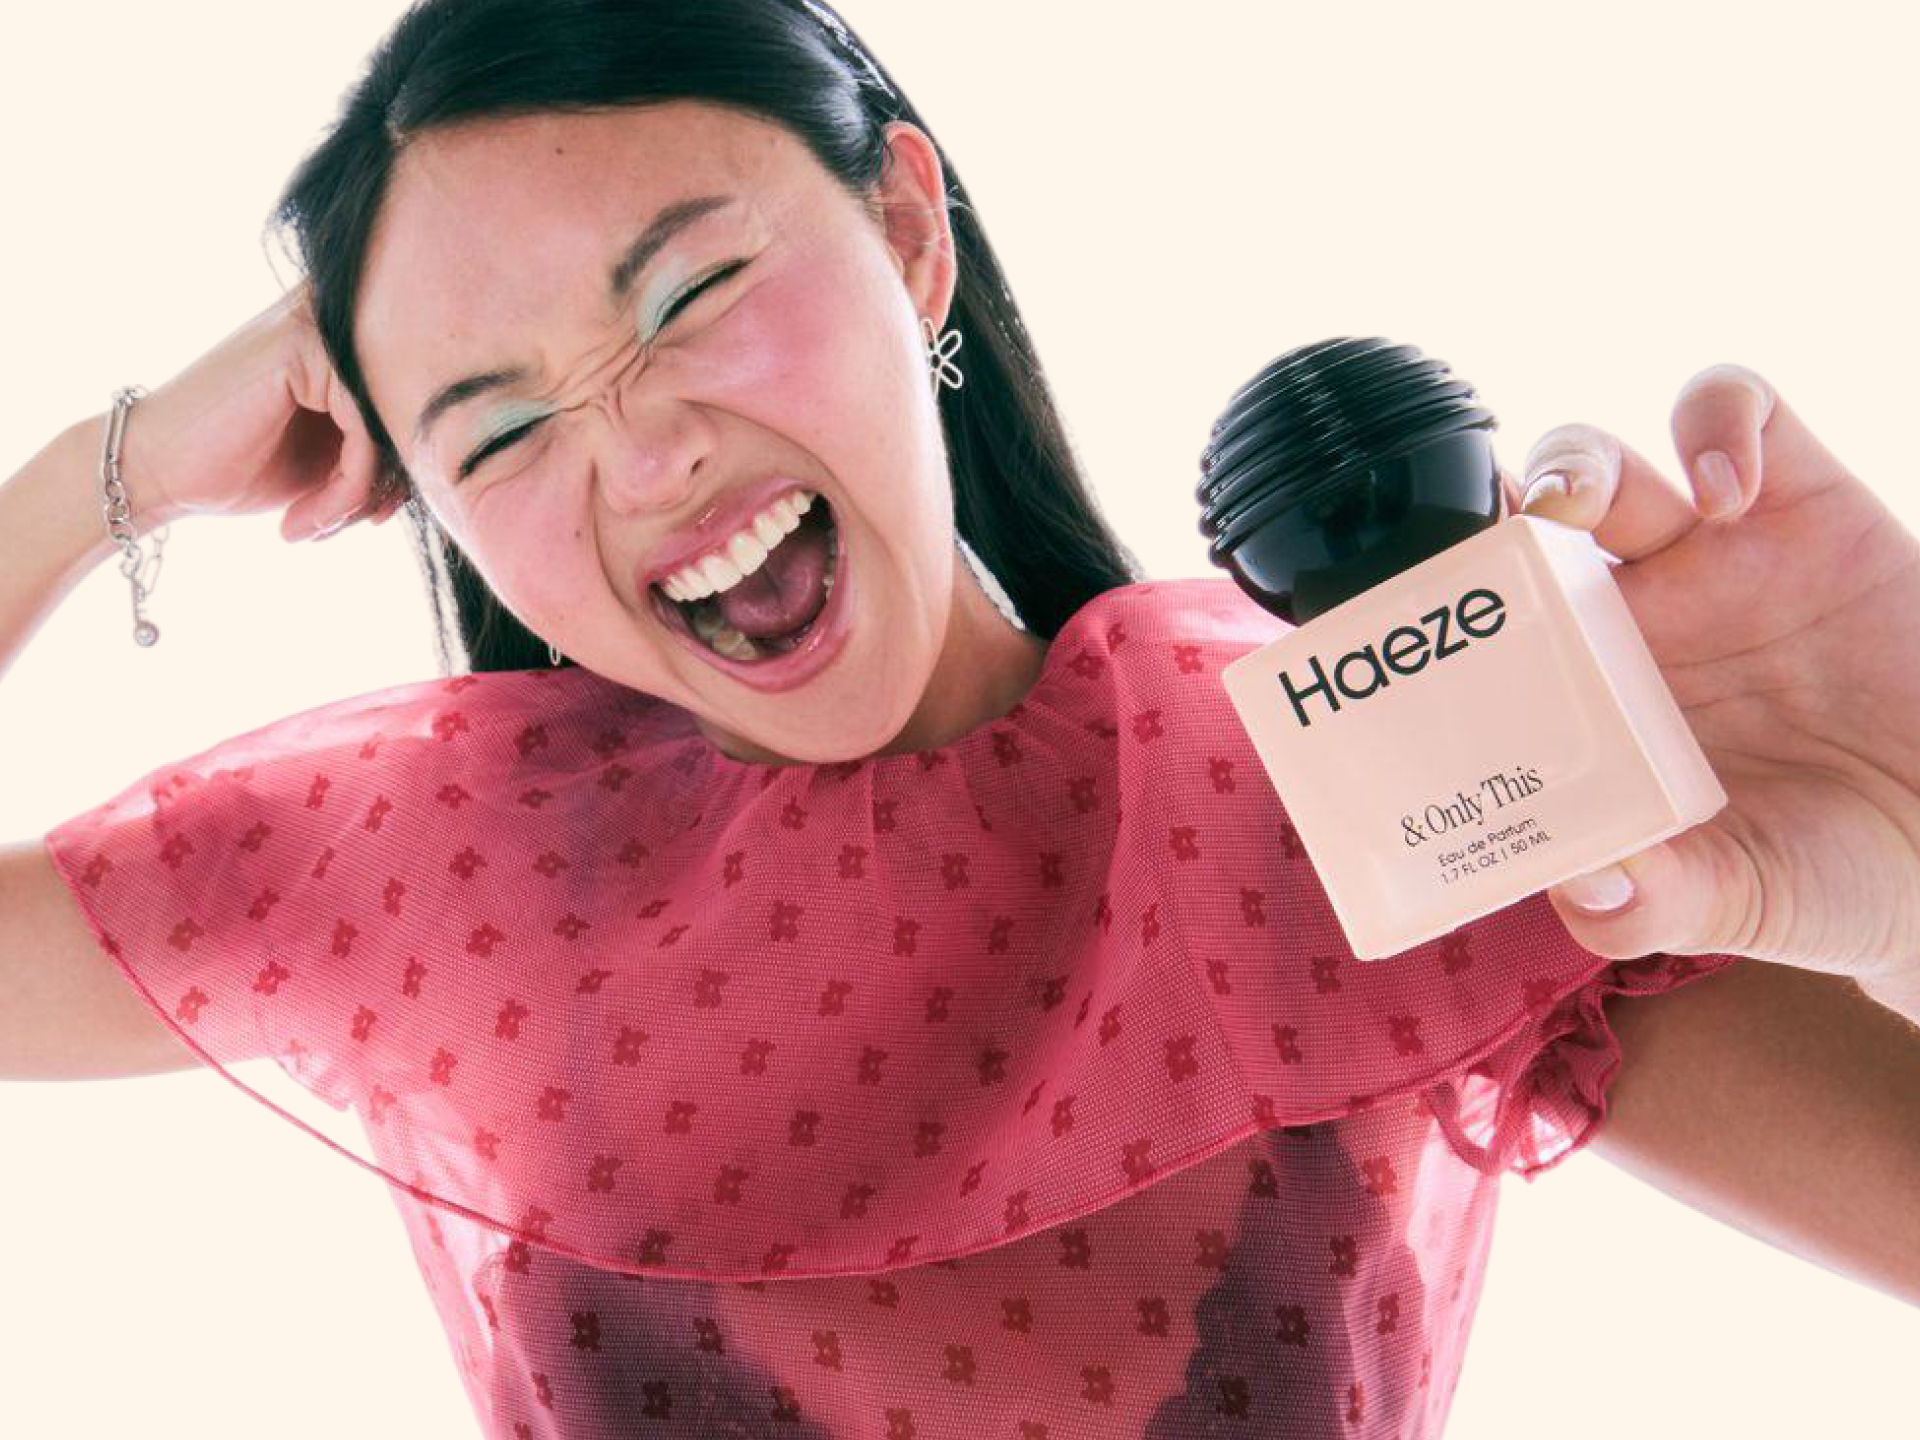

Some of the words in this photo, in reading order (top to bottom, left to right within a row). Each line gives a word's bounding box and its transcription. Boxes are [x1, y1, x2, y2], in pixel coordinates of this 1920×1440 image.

[1278, 588, 1506, 727] Haeze
[1400, 815, 1427, 847] &
[1424, 791, 1484, 834] Only
[1480, 766, 1544, 808] This
[1438, 849, 1465, 867] Eau
[1468, 840, 1486, 854] de
[1487, 819, 1537, 844] Parfum
[1461, 861, 1477, 875] FL
[1478, 852, 1499, 868] OZ
[1511, 838, 1528, 855] 50
[1529, 830, 1551, 846] ML
